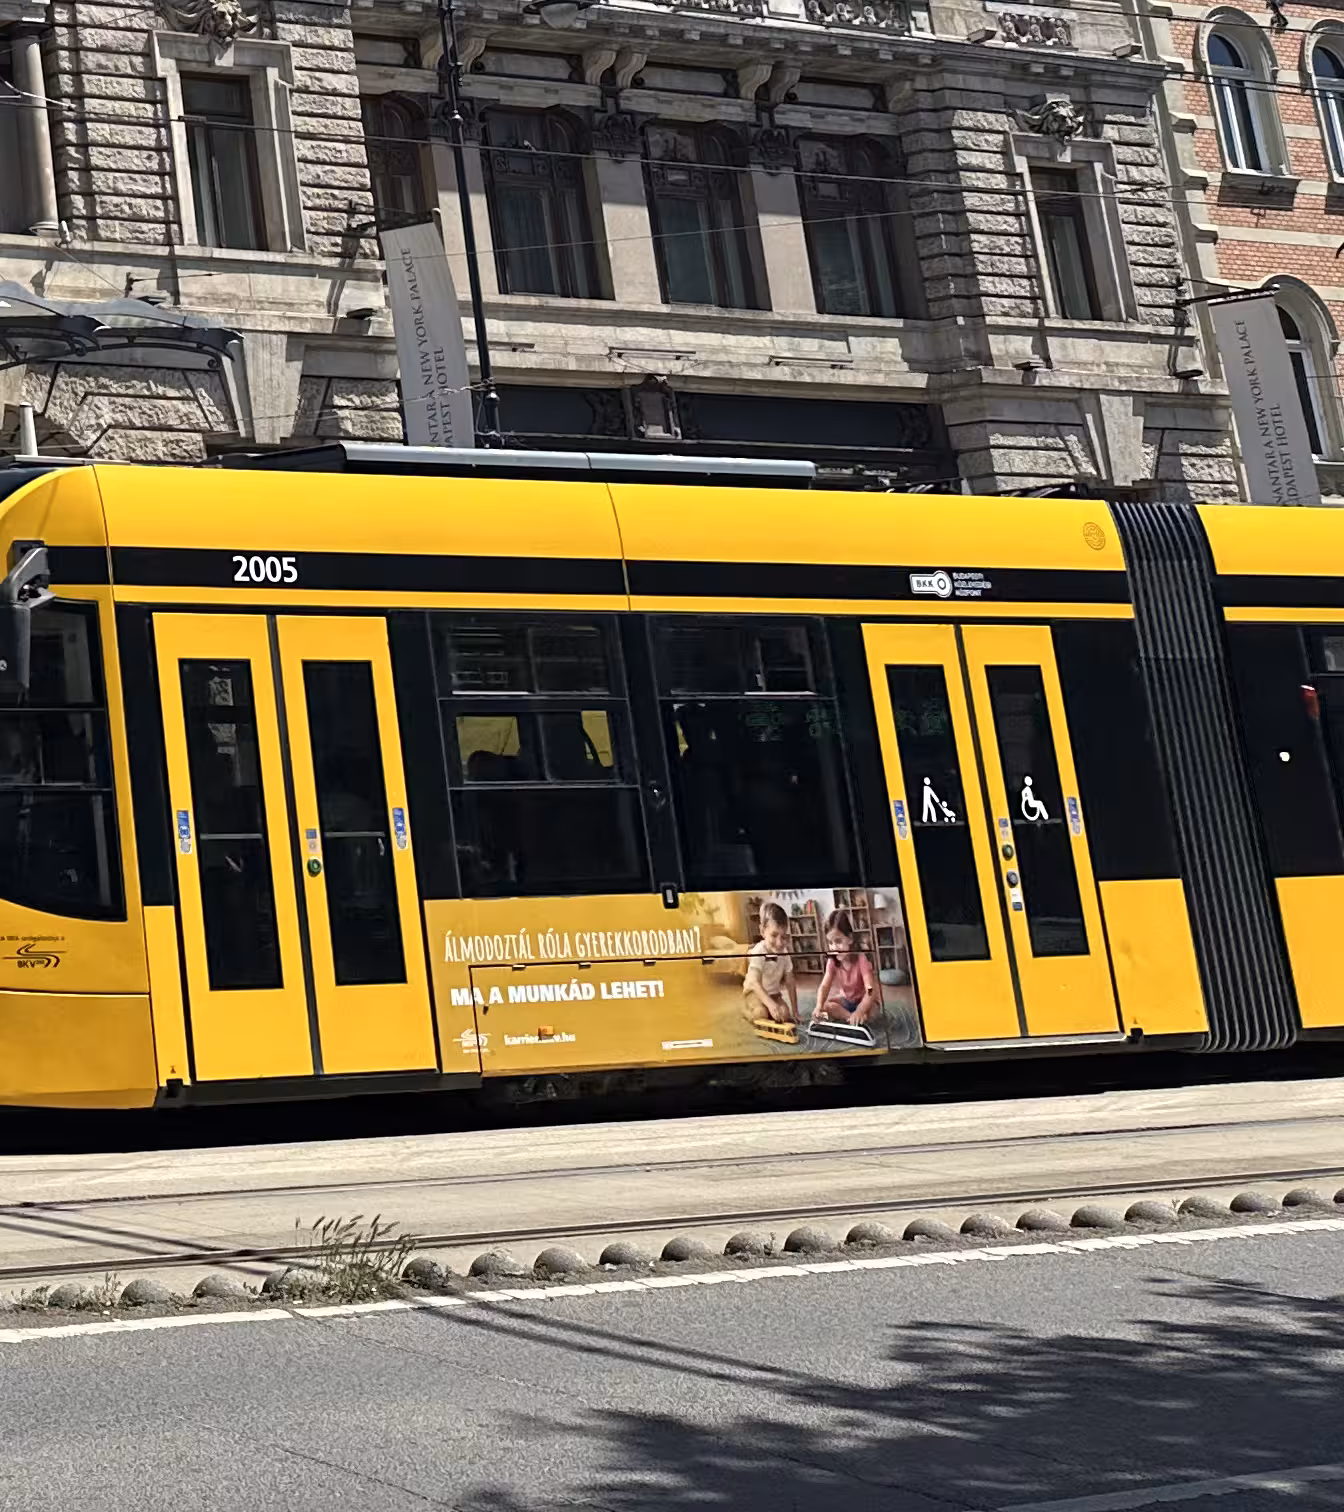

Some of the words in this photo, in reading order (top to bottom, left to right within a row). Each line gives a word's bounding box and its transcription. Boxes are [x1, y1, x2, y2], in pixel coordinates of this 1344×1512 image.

[401, 247, 421, 302] PALACE
[413, 304, 428, 347] YORK
[1235, 320, 1257, 365] PALACE
[421, 351, 434, 385] NEW
[433, 346, 449, 396] HOTEL
[1248, 368, 1264, 405] YORK
[1255, 407, 1270, 437] NEW
[1269, 403, 1288, 446] HOTEL
[232, 555, 298, 583] 2005
[916, 579, 934, 588] BKK
[444, 928, 535, 963] ÁLMODOZTÁL
[538, 928, 572, 959] RÓLA
[574, 926, 702, 958] GYEREKKORODBAN?
[450, 986, 485, 1007] MA
[488, 986, 504, 1005] A
[508, 979, 596, 1003] MUNKÁD
[600, 980, 665, 1000] LEHET!
